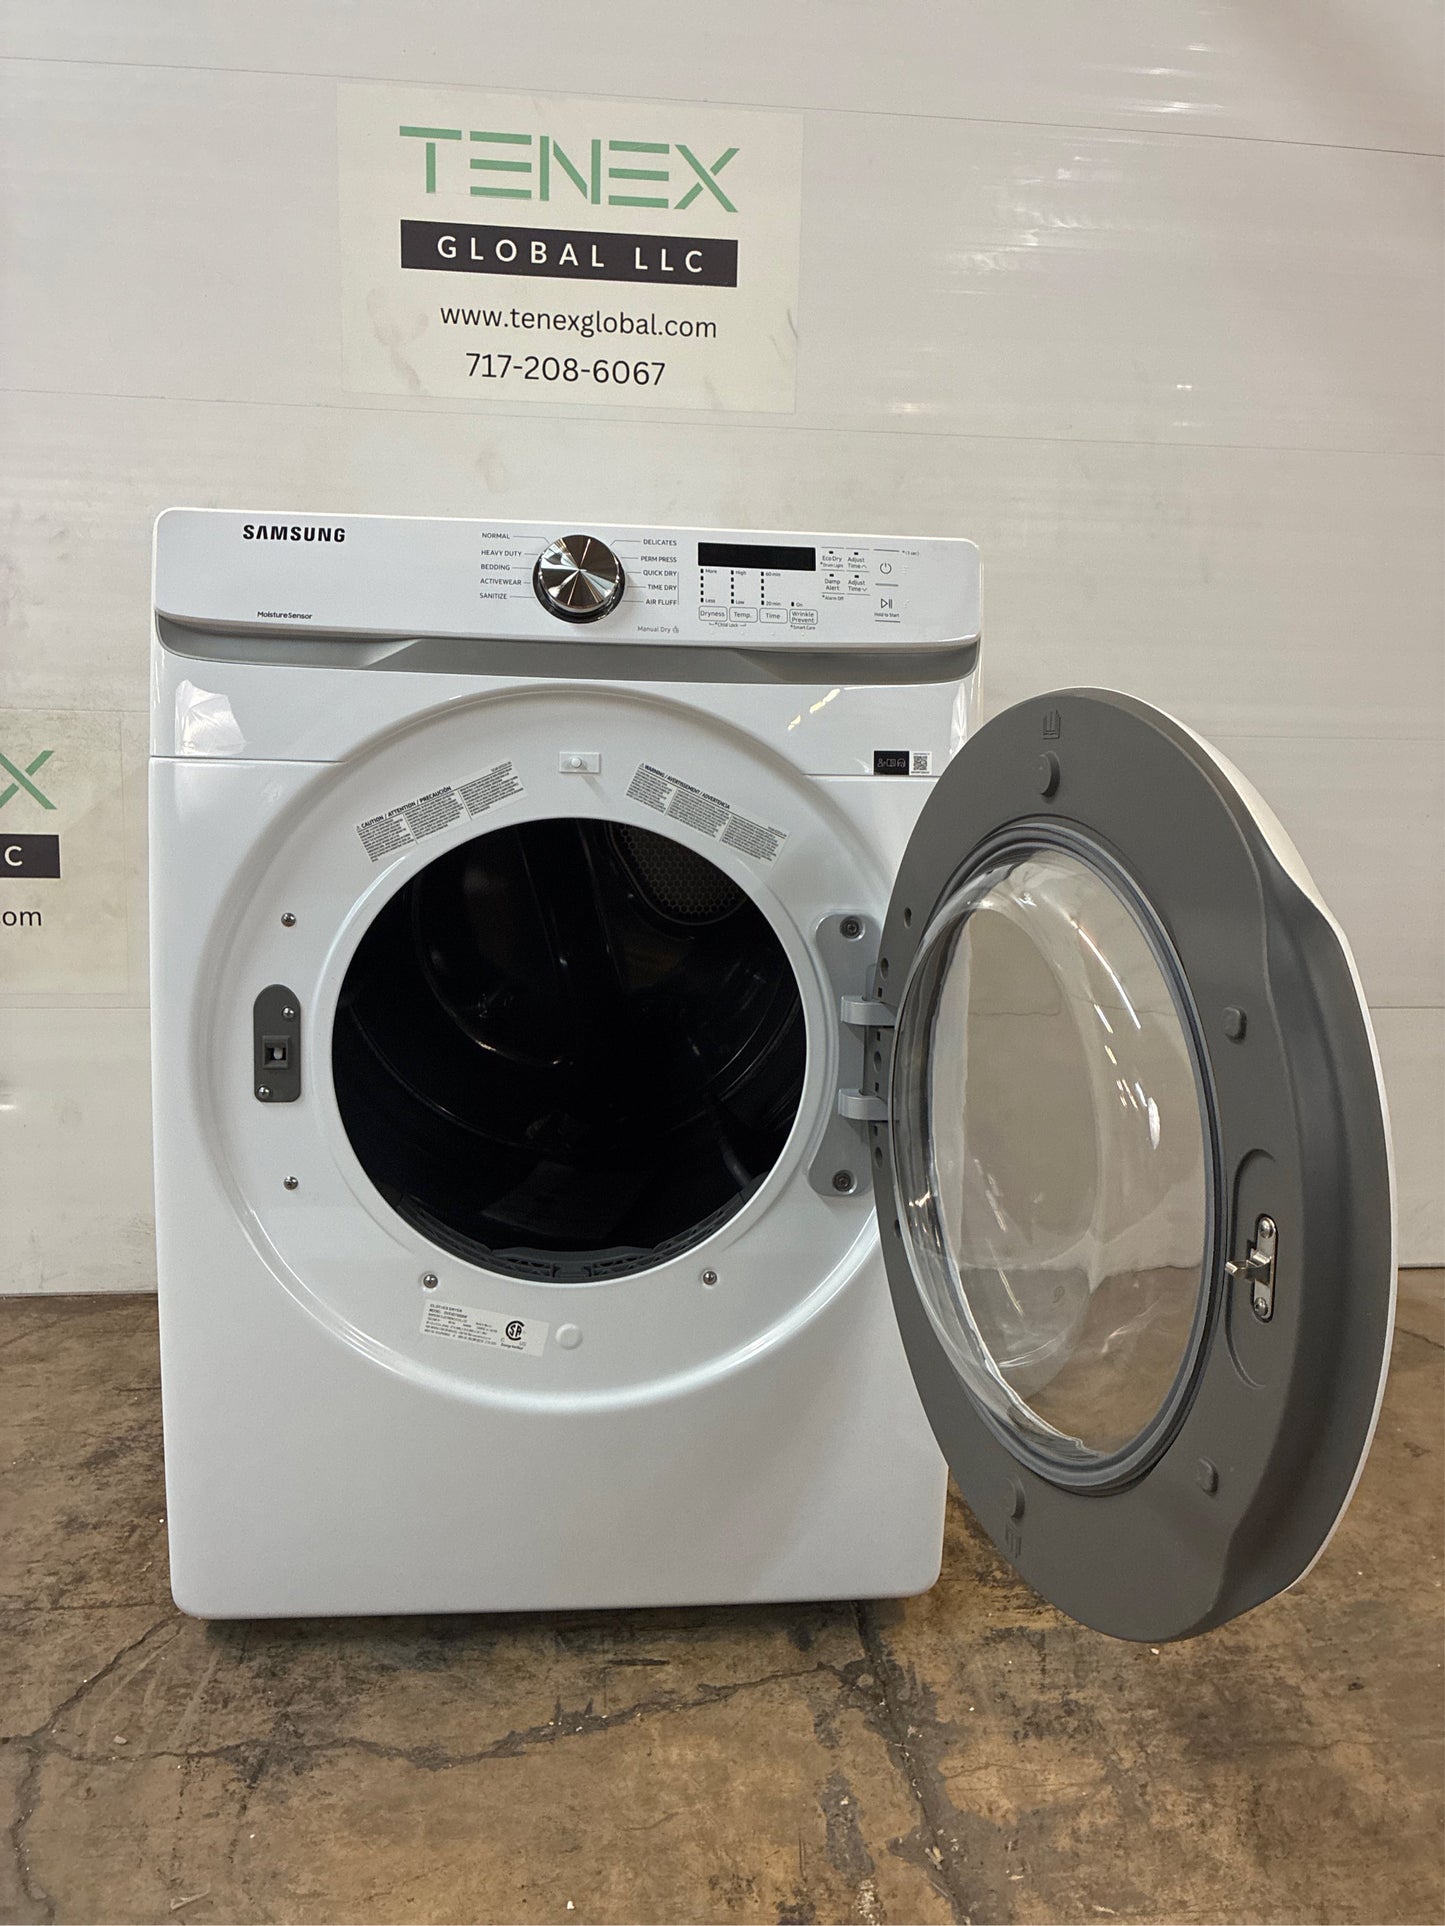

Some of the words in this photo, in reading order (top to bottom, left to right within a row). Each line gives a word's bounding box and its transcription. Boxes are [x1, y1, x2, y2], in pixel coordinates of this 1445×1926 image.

[399, 125, 740, 213] TENEX
[437, 235, 604, 267] GLOBAL
[634, 247, 703, 273] LLC
[440, 307, 717, 338] www.tenexglobal.com
[465, 353, 666, 386] 717-208-6067
[242, 524, 346, 543] SAMSUNG
[481, 532, 510, 540] NORMAL
[643, 538, 677, 546] DELICATES
[481, 549, 503, 557] HEAVY
[480, 563, 510, 571] BEDDING
[642, 569, 663, 577] QUICK
[480, 578, 522, 586] ACTIVEWEAR
[479, 592, 507, 600] SANITIZE
[700, 610, 725, 618] Dryness
[361, 815, 384, 829] CAUTION
[387, 802, 416, 817] ATTENTION
